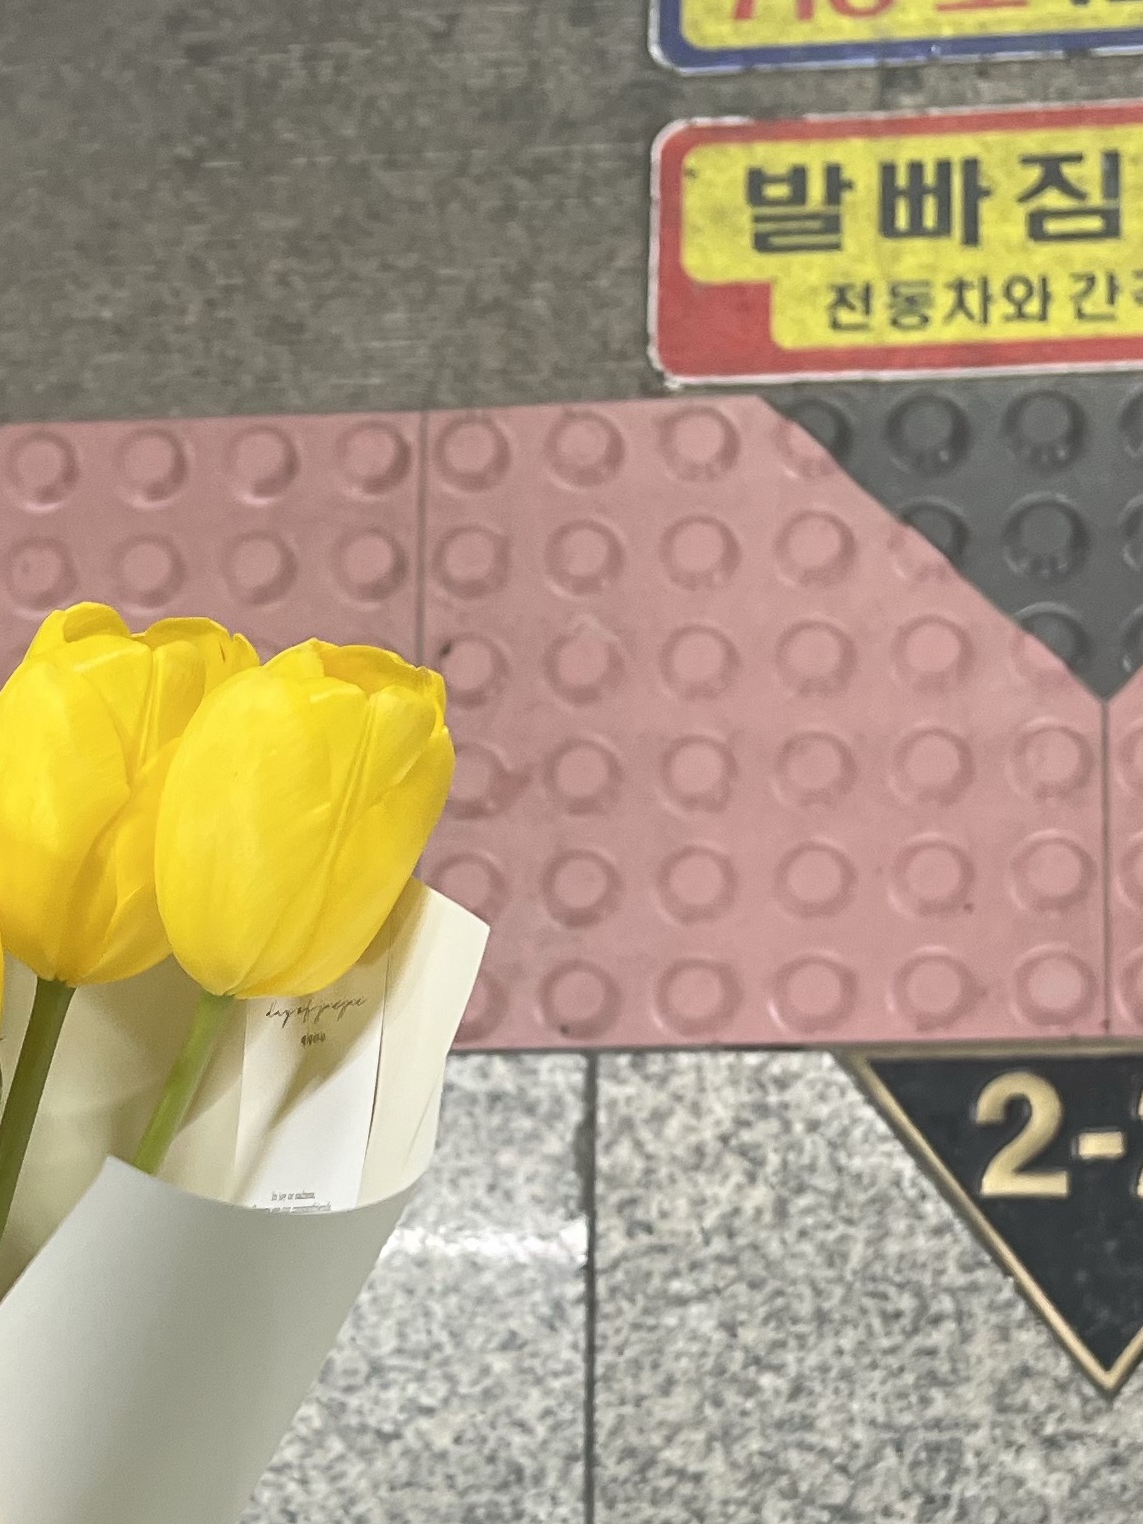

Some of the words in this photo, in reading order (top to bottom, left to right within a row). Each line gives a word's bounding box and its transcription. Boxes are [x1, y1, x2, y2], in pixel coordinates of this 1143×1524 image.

[745, 149, 1121, 253] 발빠짐
[1069, 269, 1143, 322] 간
[975, 1070, 1143, 1197] 2-
